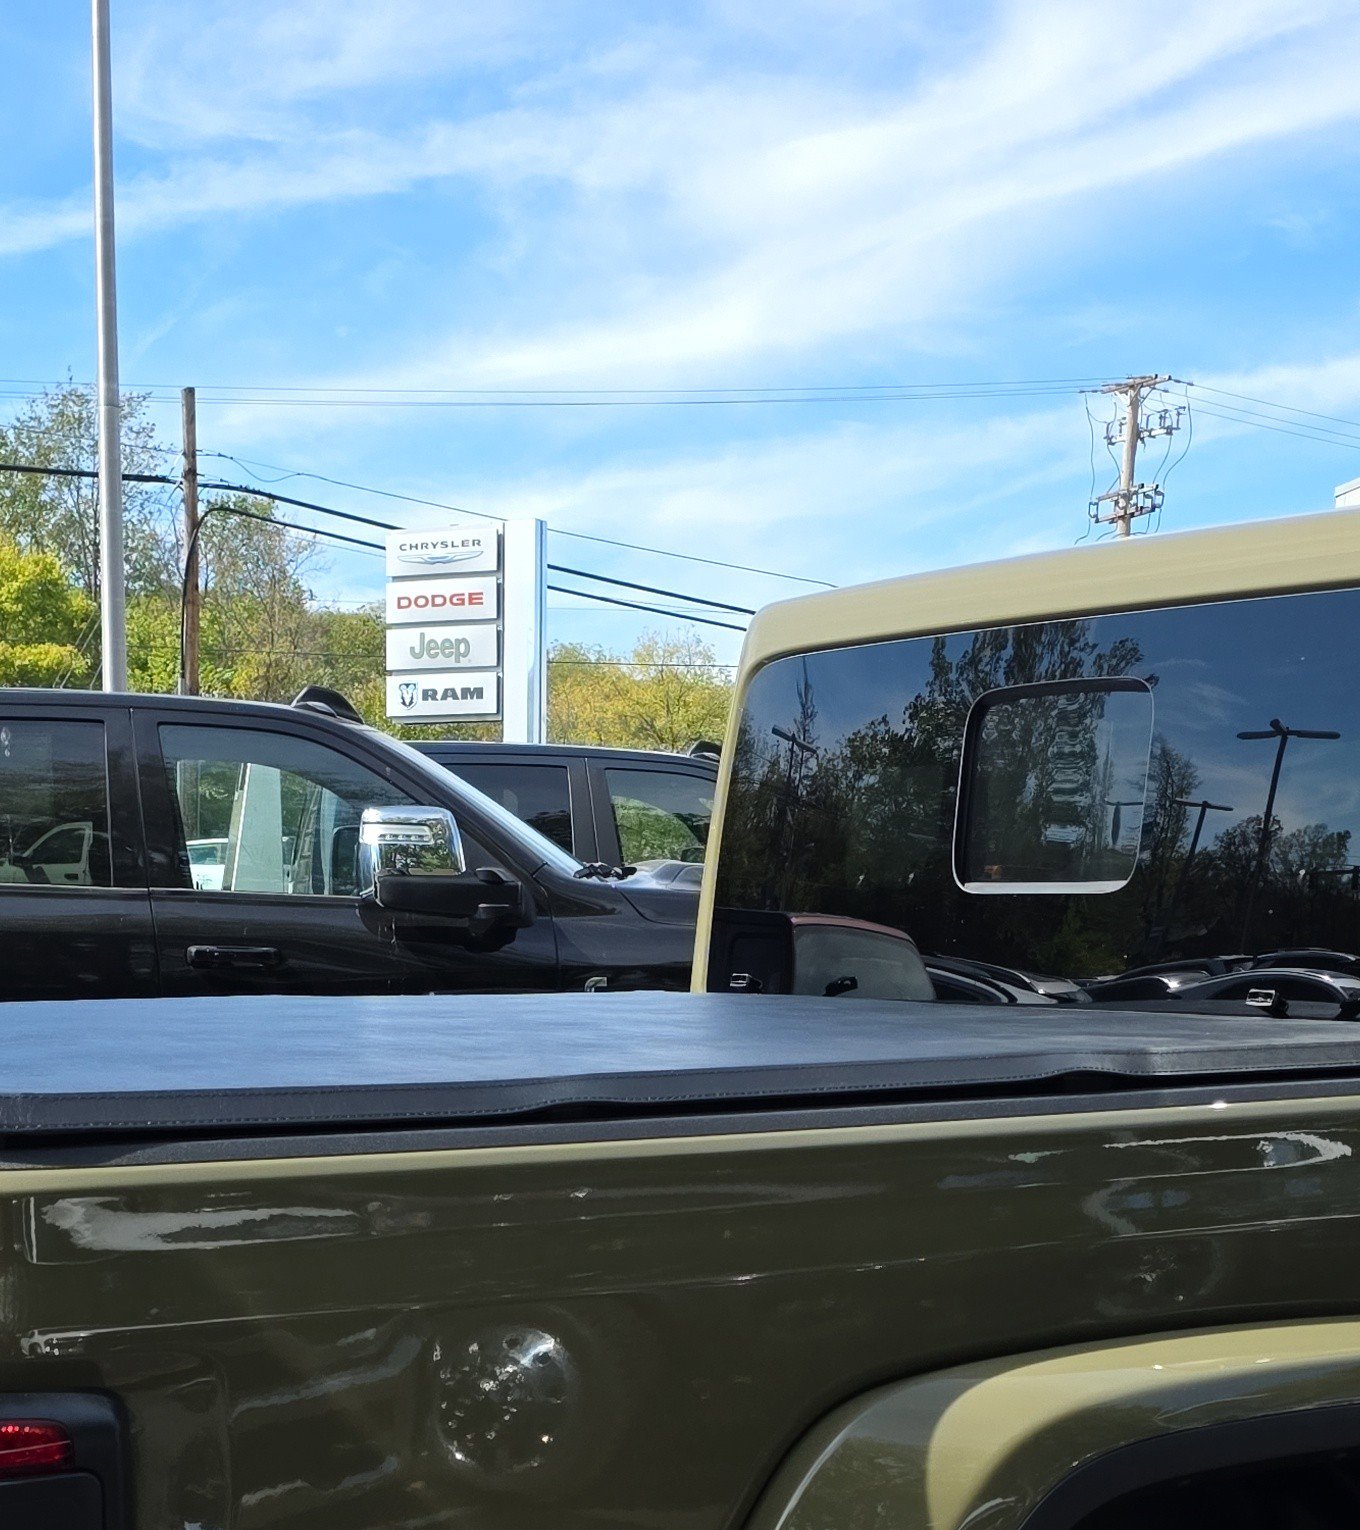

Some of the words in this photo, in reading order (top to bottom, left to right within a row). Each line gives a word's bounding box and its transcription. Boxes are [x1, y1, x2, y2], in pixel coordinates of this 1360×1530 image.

[398, 538, 482, 552] CHRYSLER
[396, 592, 484, 610] DODGE
[409, 632, 471, 664] Jeep
[421, 686, 484, 702] RAM
